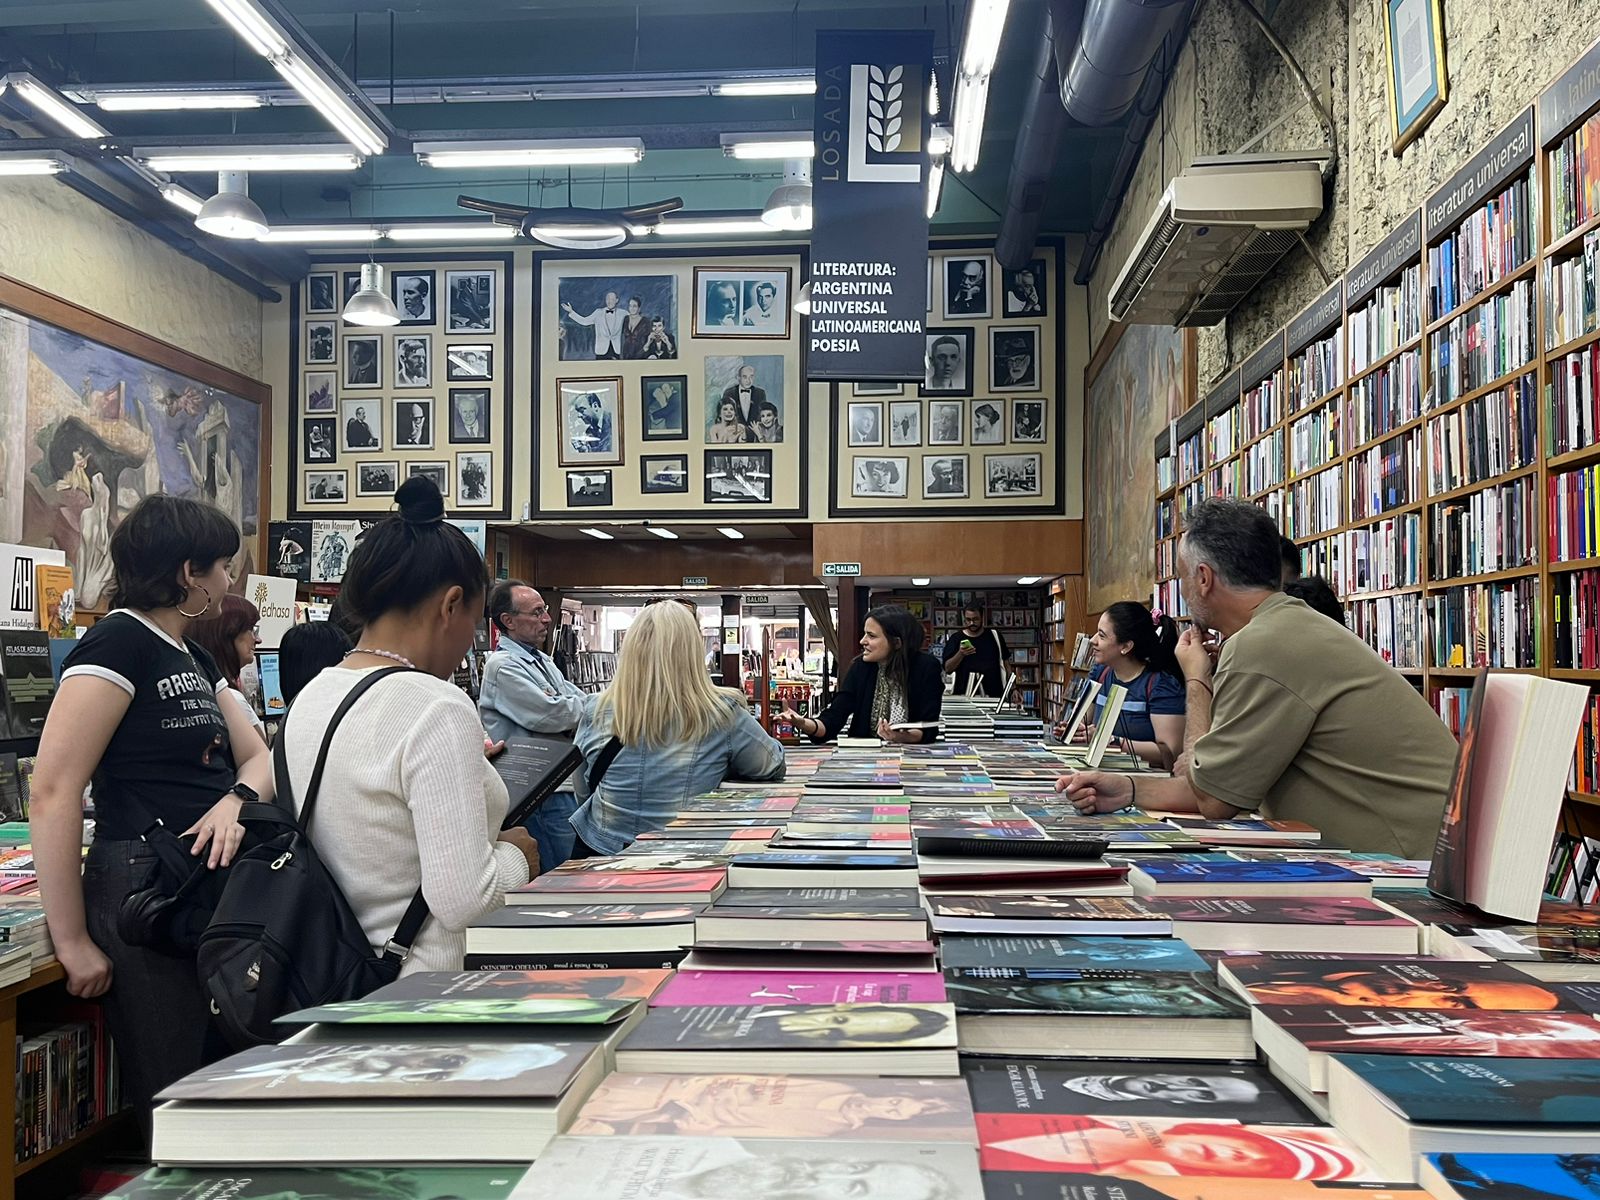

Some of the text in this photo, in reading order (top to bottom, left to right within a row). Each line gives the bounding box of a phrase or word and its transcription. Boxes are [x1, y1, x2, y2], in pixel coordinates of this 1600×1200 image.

[821, 66, 842, 181] LOSADA
[1427, 123, 1529, 232] literatura universal
[1381, 222, 1418, 270] universal
[813, 262, 896, 276] LITERATURA:
[811, 281, 893, 295] ARGENTINA
[812, 300, 888, 314] UNIVERSAL
[1289, 291, 1340, 346] teratura universal
[811, 320, 922, 333] LATINOAMERICANA
[811, 339, 861, 352] POESIA
[313, 520, 356, 532] Mein Kampf
[836, 565, 859, 574] SALIDA
[685, 577, 706, 585] SALIDA
[261, 602, 290, 618] edhasa
[12, 618, 34, 631] Hidalgo
[6, 645, 20, 653] ATLAS
[180, 699, 198, 710] THE
[161, 714, 211, 729] COUNTRY
[636, 1147, 660, 1167] WALT
